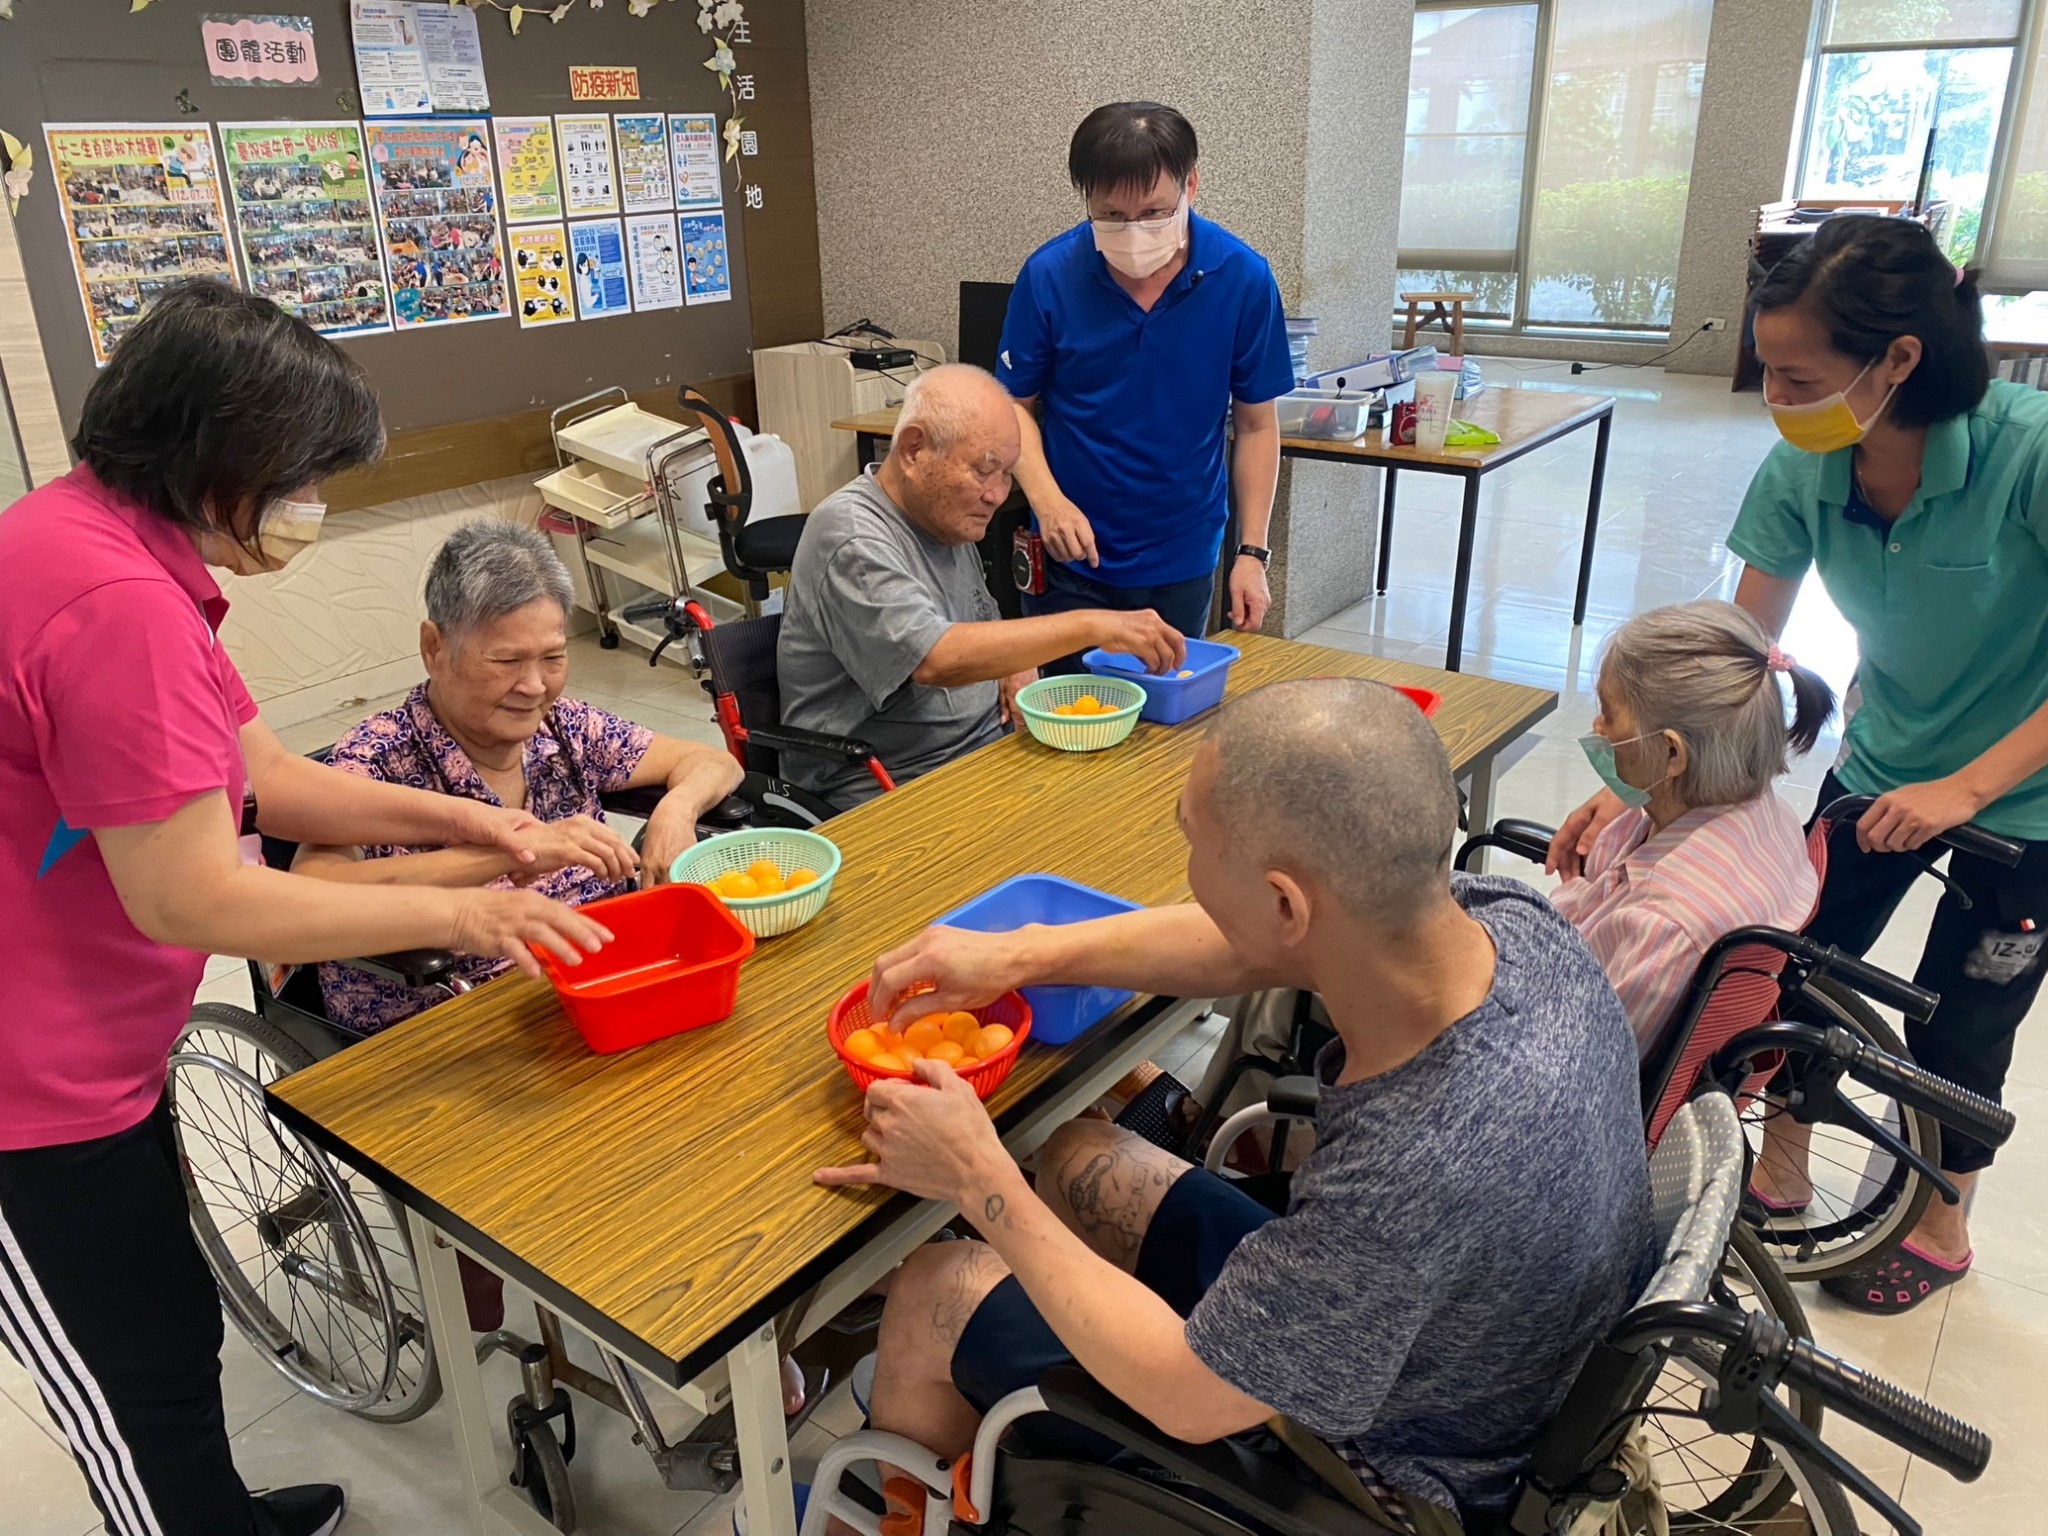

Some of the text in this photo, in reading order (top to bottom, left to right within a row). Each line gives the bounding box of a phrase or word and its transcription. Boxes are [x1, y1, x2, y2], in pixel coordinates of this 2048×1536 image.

[216, 38, 306, 64] 團體活動
[571, 69, 637, 98] 防疫新知
[734, 20, 763, 209] 生活園地
[170, 187, 214, 200] 112.07.10
[767, 778, 790, 797] 11.5
